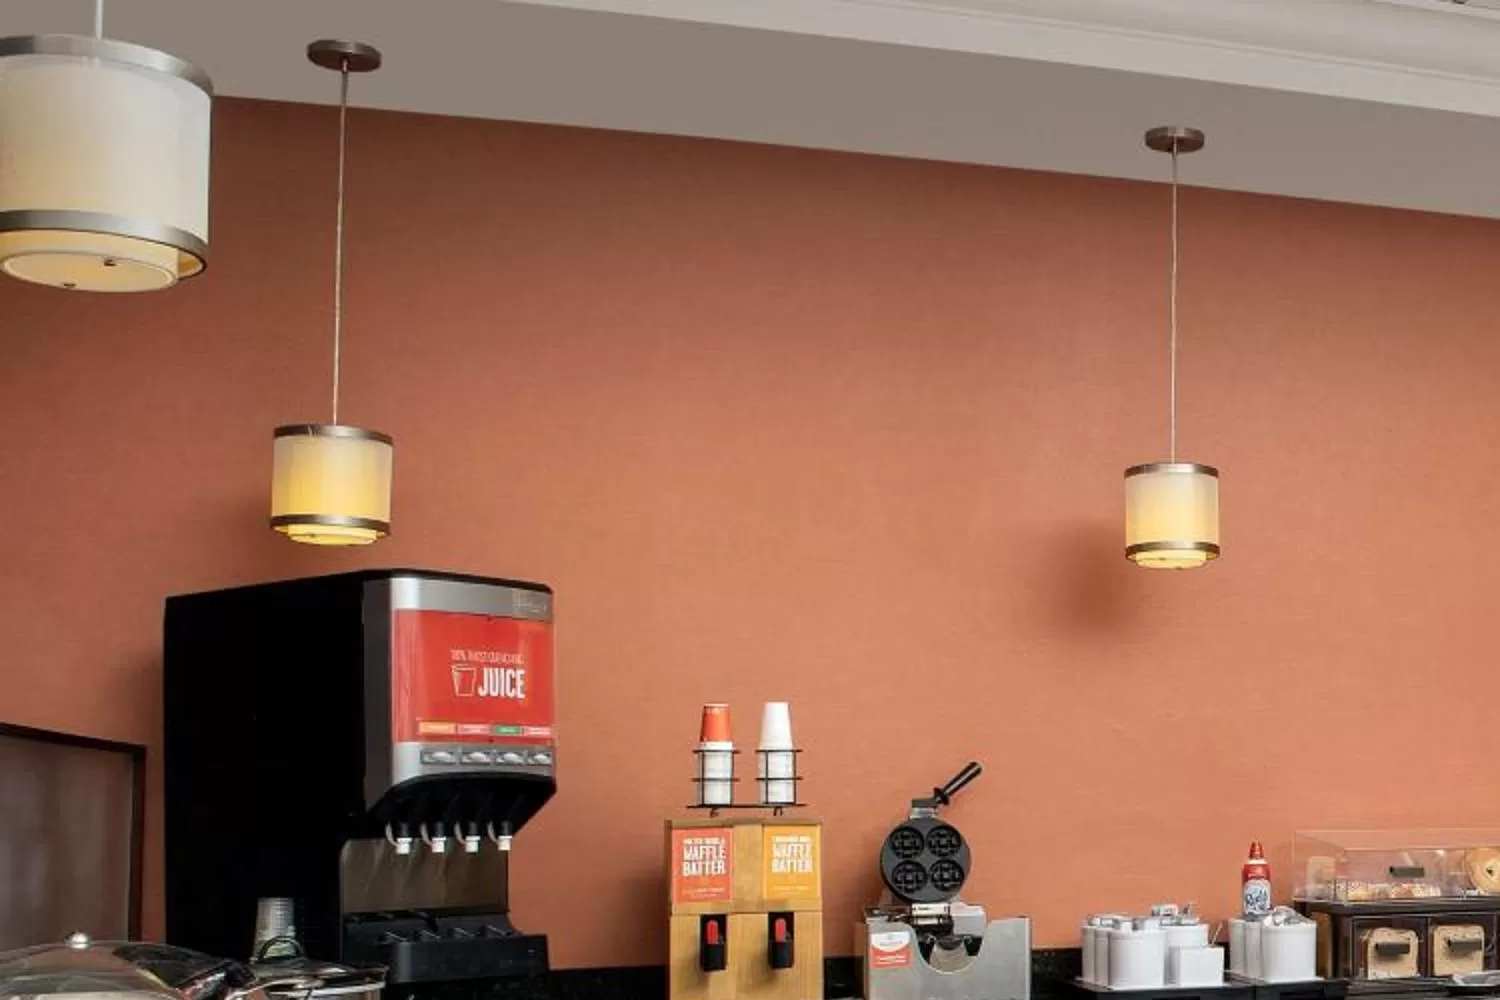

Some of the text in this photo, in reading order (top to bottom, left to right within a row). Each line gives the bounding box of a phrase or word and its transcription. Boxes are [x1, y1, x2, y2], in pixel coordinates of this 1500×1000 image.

[477, 667, 526, 699] JUICE
[683, 844, 727, 861] WAFFLE
[682, 859, 727, 877] BATTER
